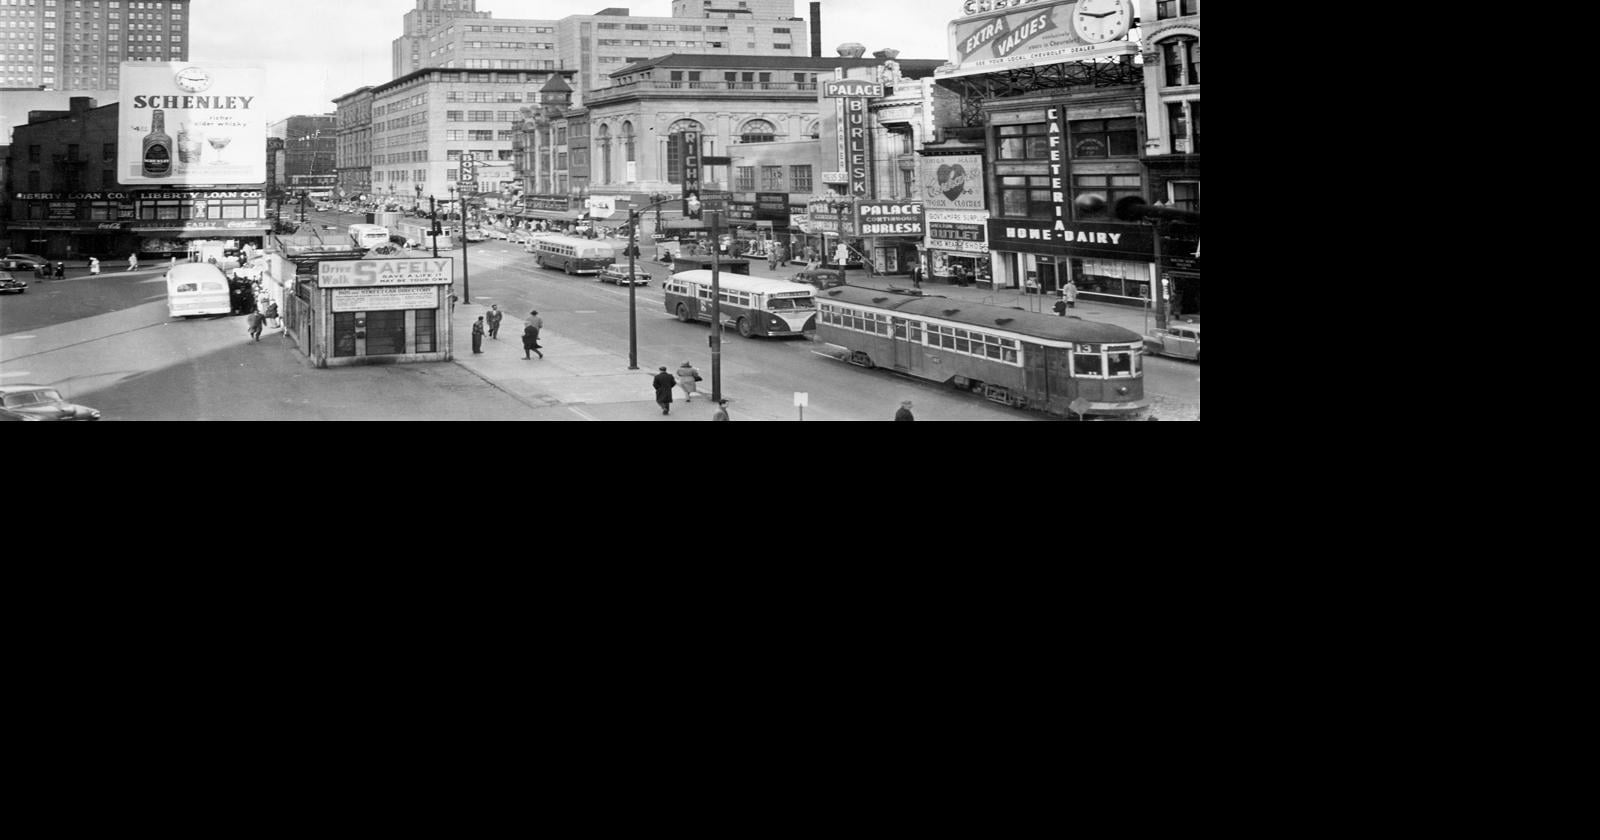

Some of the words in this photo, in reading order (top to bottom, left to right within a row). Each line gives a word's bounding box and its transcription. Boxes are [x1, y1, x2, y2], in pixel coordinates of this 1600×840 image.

[966, 18, 1004, 53] EXTRA
[998, 14, 1048, 56] VALUES
[1030, 49, 1066, 59] CHEVROLET
[829, 84, 882, 96] PALACE
[134, 95, 255, 109] SCHENLEY
[850, 100, 865, 192] BURLESK
[462, 154, 473, 180] BOND
[685, 133, 700, 215] RICHMN
[1048, 109, 1065, 230] CAFETERIA
[861, 205, 921, 215] PALACE
[862, 223, 922, 234] BURLESK
[931, 229, 979, 240] OUTLET
[322, 264, 351, 274] Drive
[353, 260, 448, 284] SAFELY
[322, 275, 350, 285] Walk
[1076, 344, 1092, 353] 13
